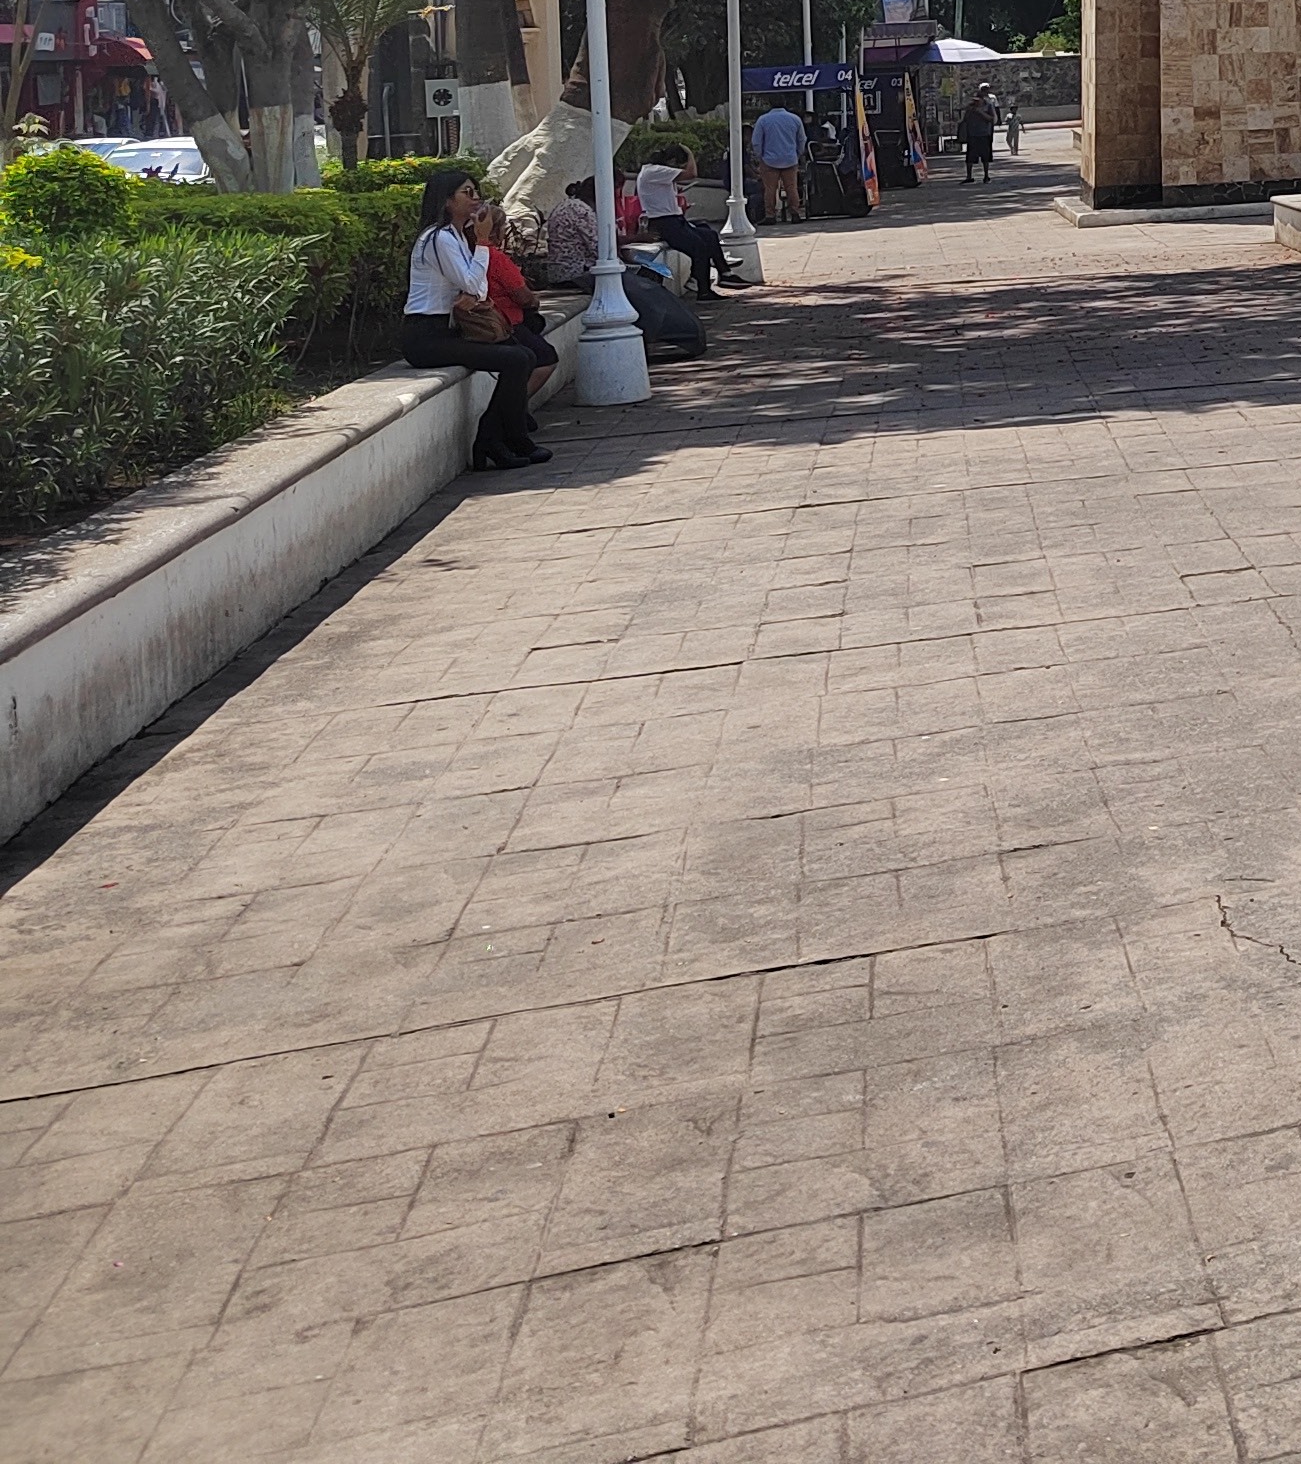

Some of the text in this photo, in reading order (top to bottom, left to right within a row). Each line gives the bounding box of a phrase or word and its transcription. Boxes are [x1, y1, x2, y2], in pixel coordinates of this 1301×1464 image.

[773, 69, 853, 87] telcel 04
[891, 77, 903, 87] 03
